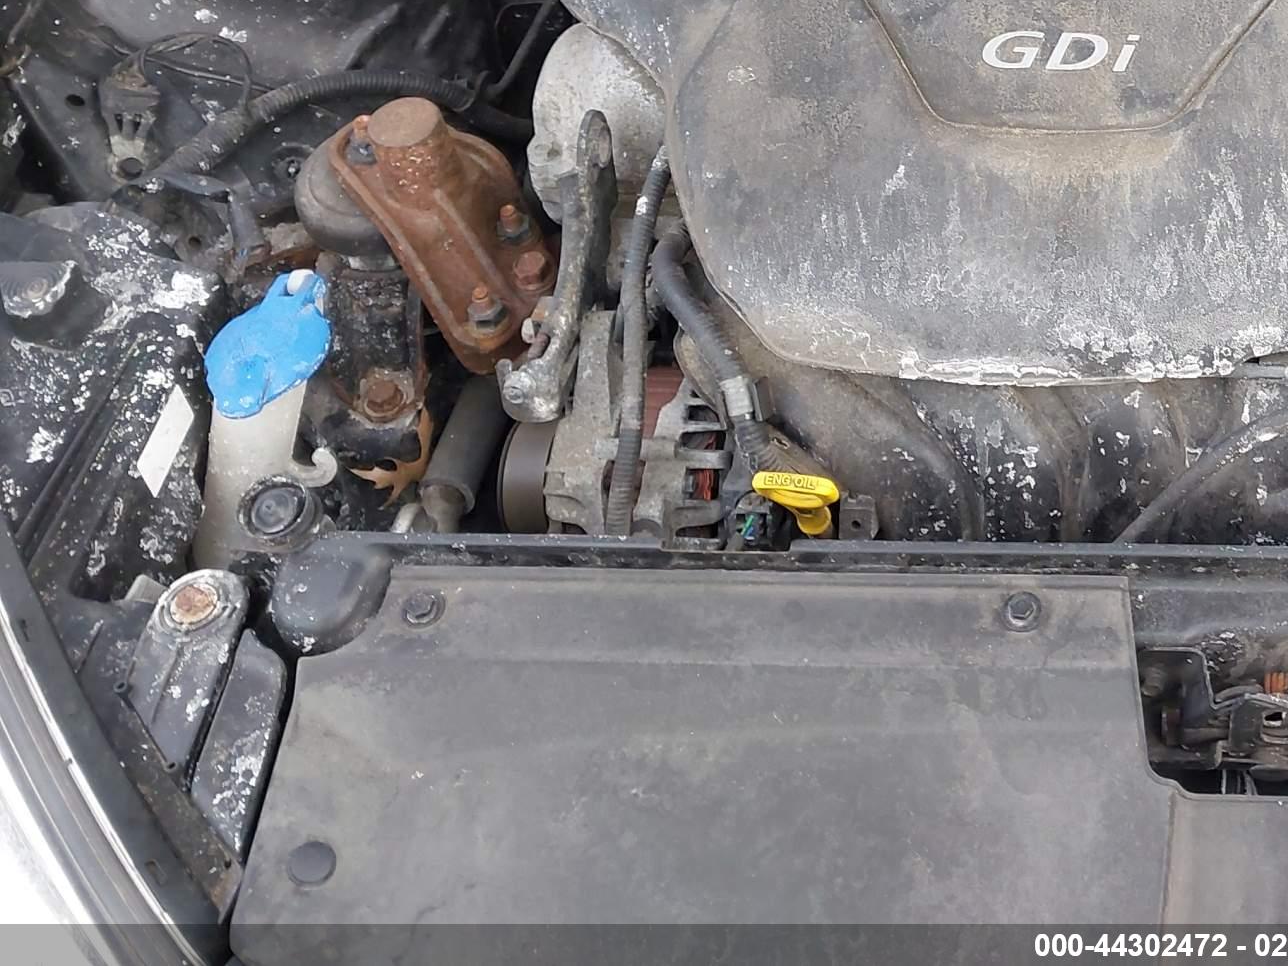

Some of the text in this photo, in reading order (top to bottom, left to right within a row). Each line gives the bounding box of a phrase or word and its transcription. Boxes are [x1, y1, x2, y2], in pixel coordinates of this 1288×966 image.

[982, 31, 1140, 72] GDi
[764, 474, 816, 490] ENG OIL
